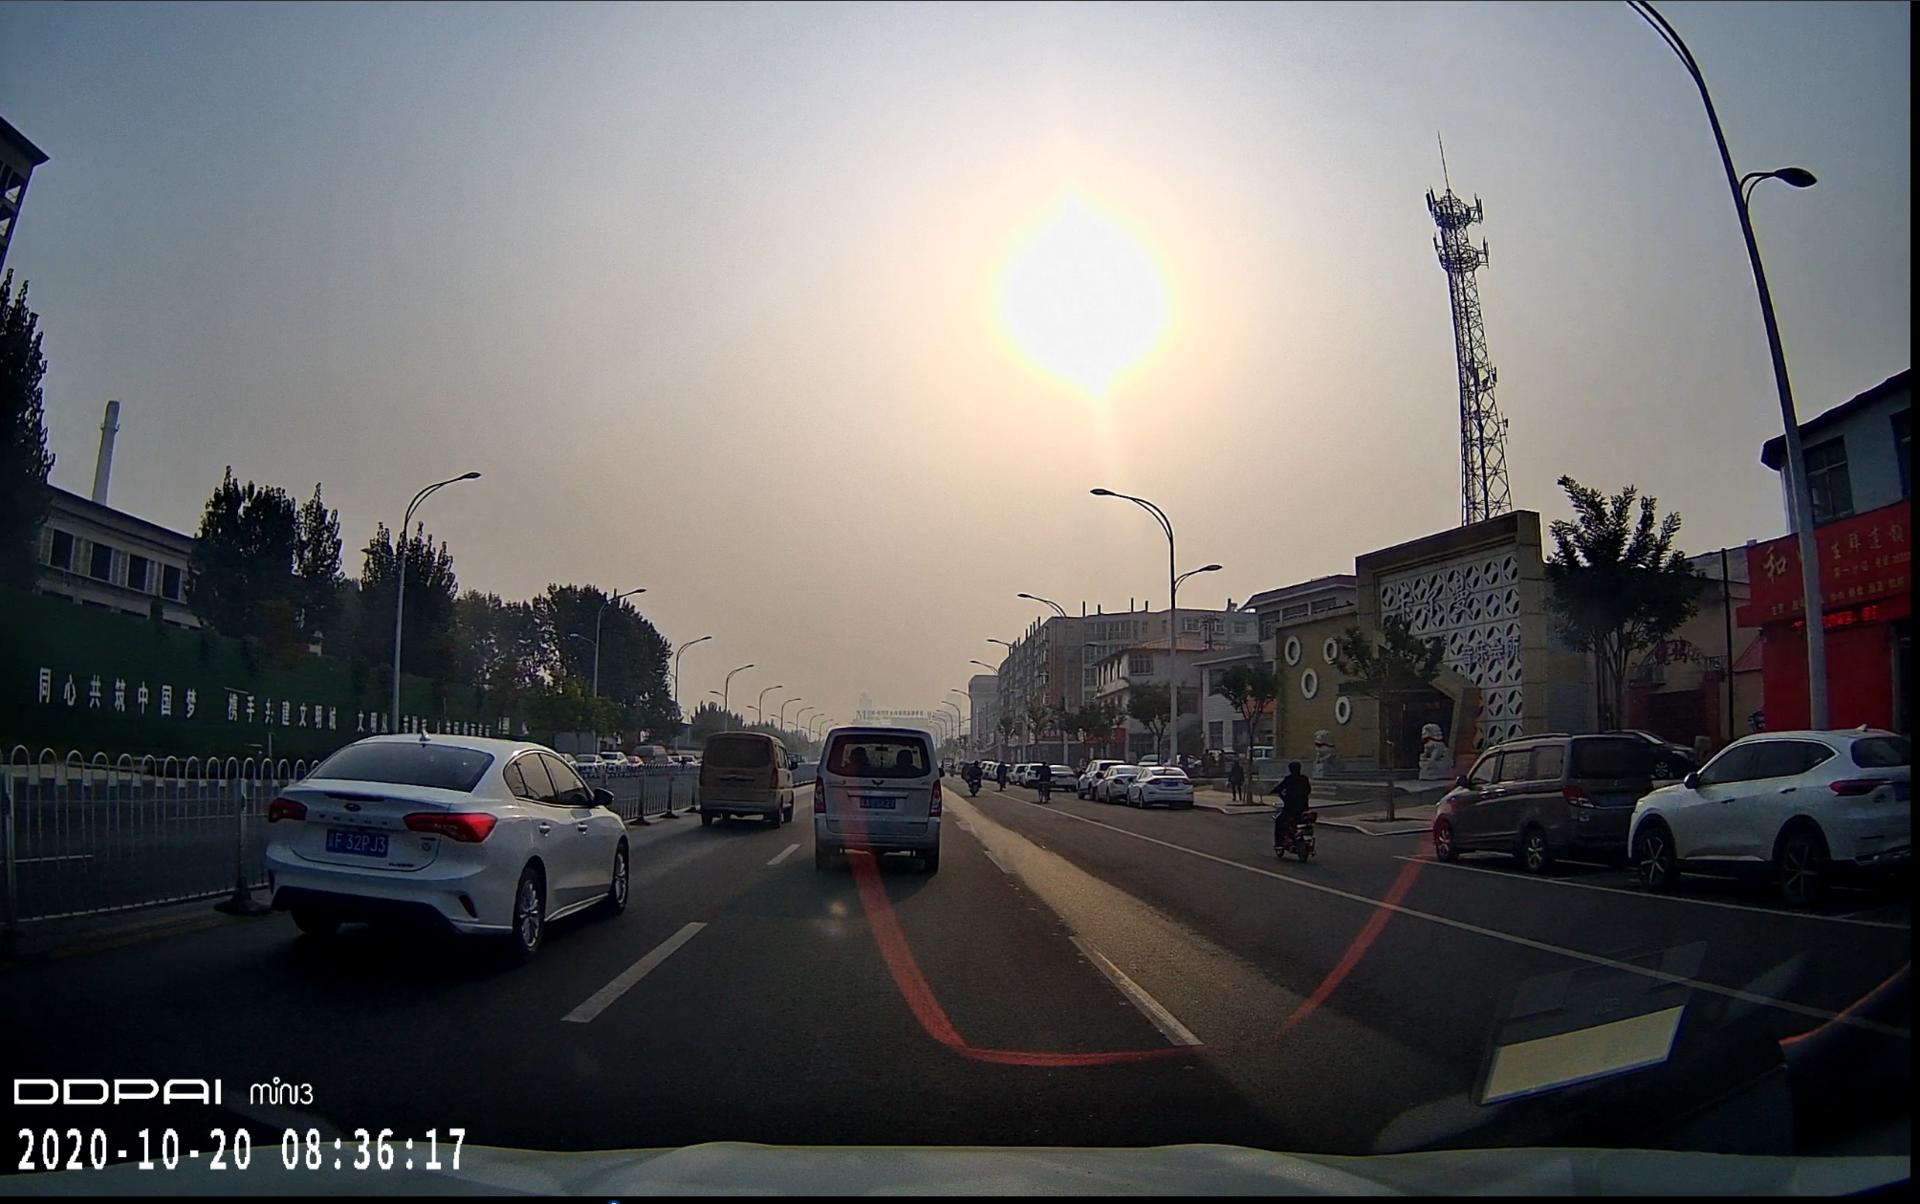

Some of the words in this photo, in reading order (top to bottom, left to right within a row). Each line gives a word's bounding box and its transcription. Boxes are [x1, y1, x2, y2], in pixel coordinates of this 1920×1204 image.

[38, 667, 197, 719] 同心共筑中国梦
